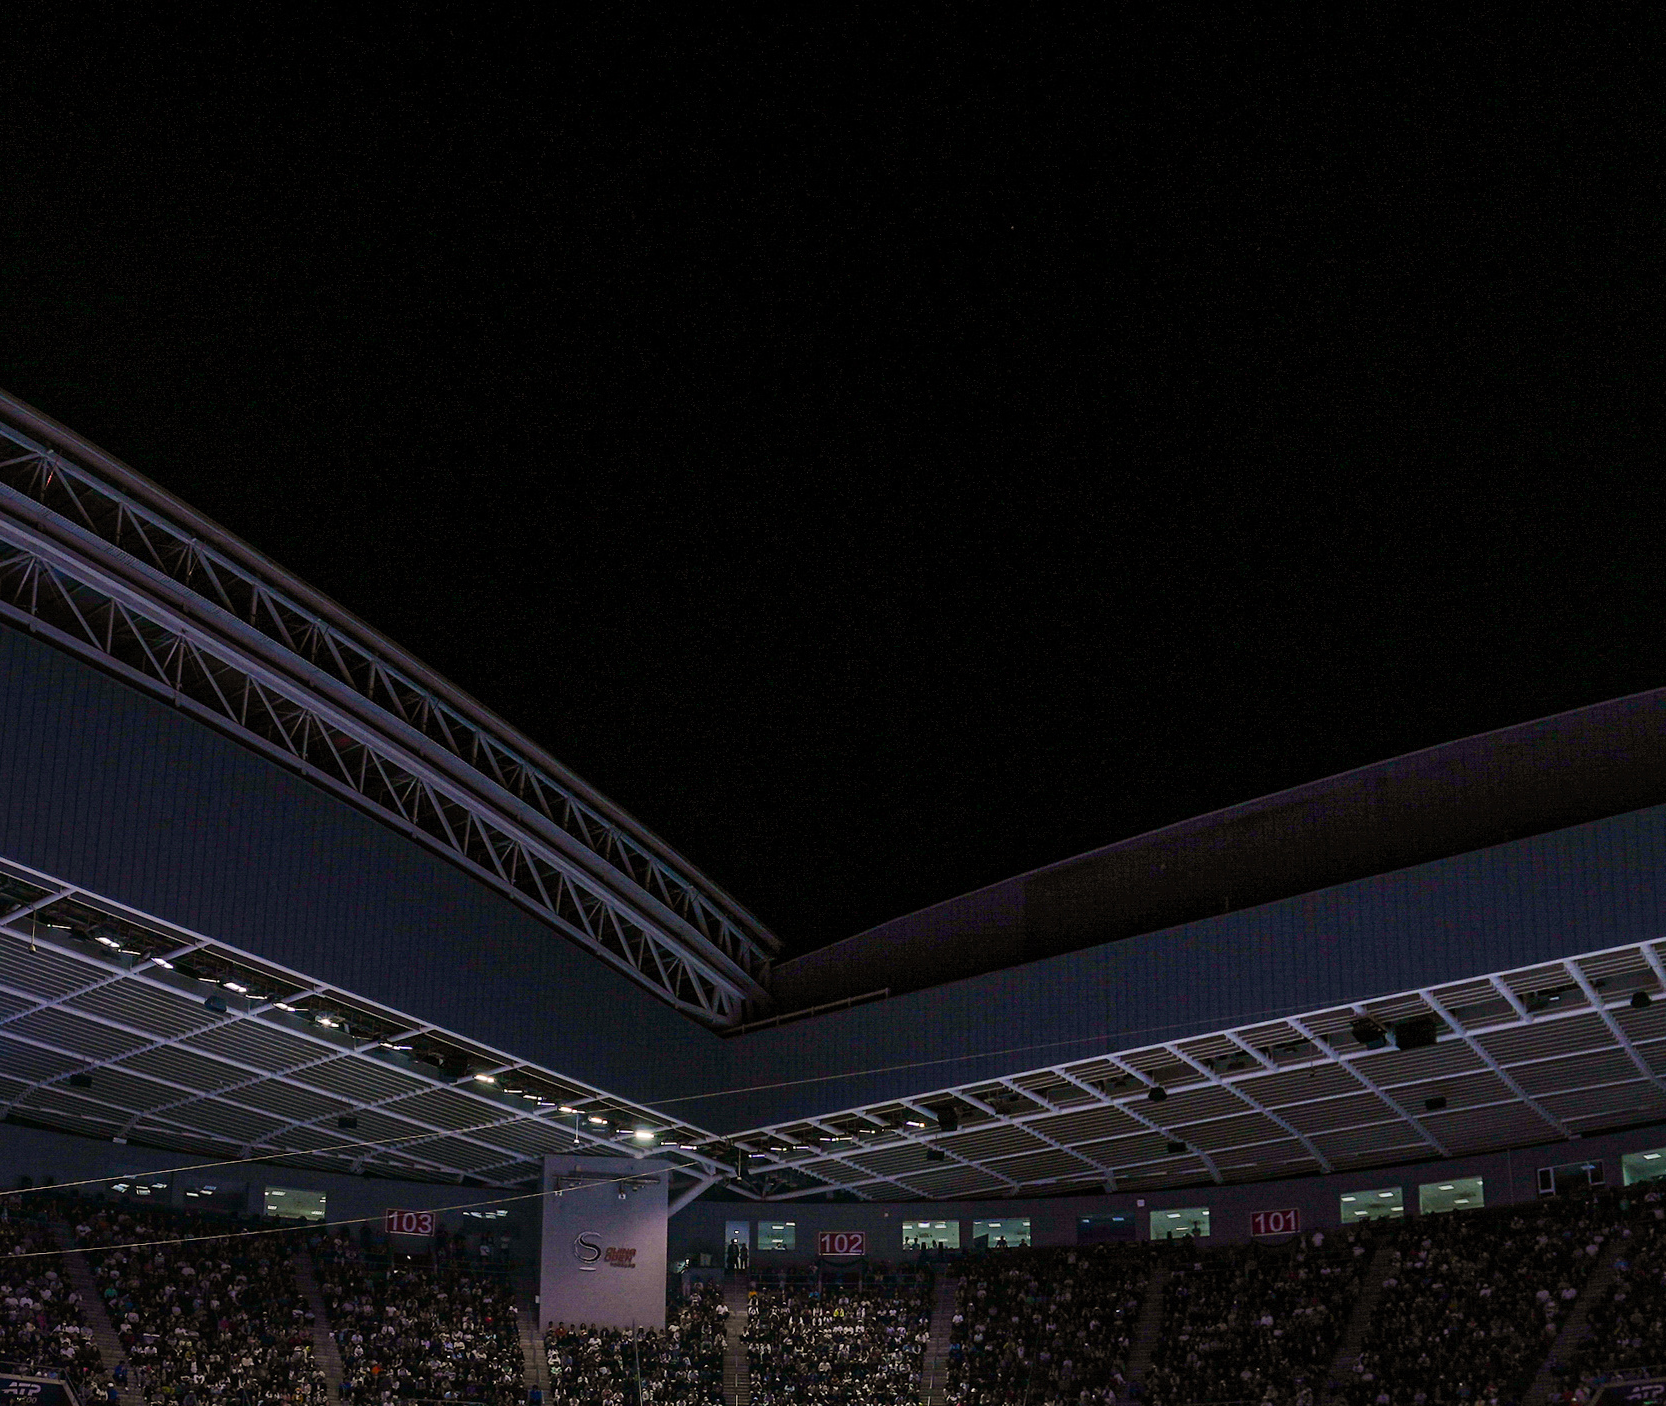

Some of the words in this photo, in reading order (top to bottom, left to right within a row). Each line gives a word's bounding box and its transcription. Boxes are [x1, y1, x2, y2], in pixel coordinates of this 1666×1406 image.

[387, 1211, 432, 1234] 103
[1255, 1211, 1297, 1234] 101
[821, 1235, 862, 1253] 102
